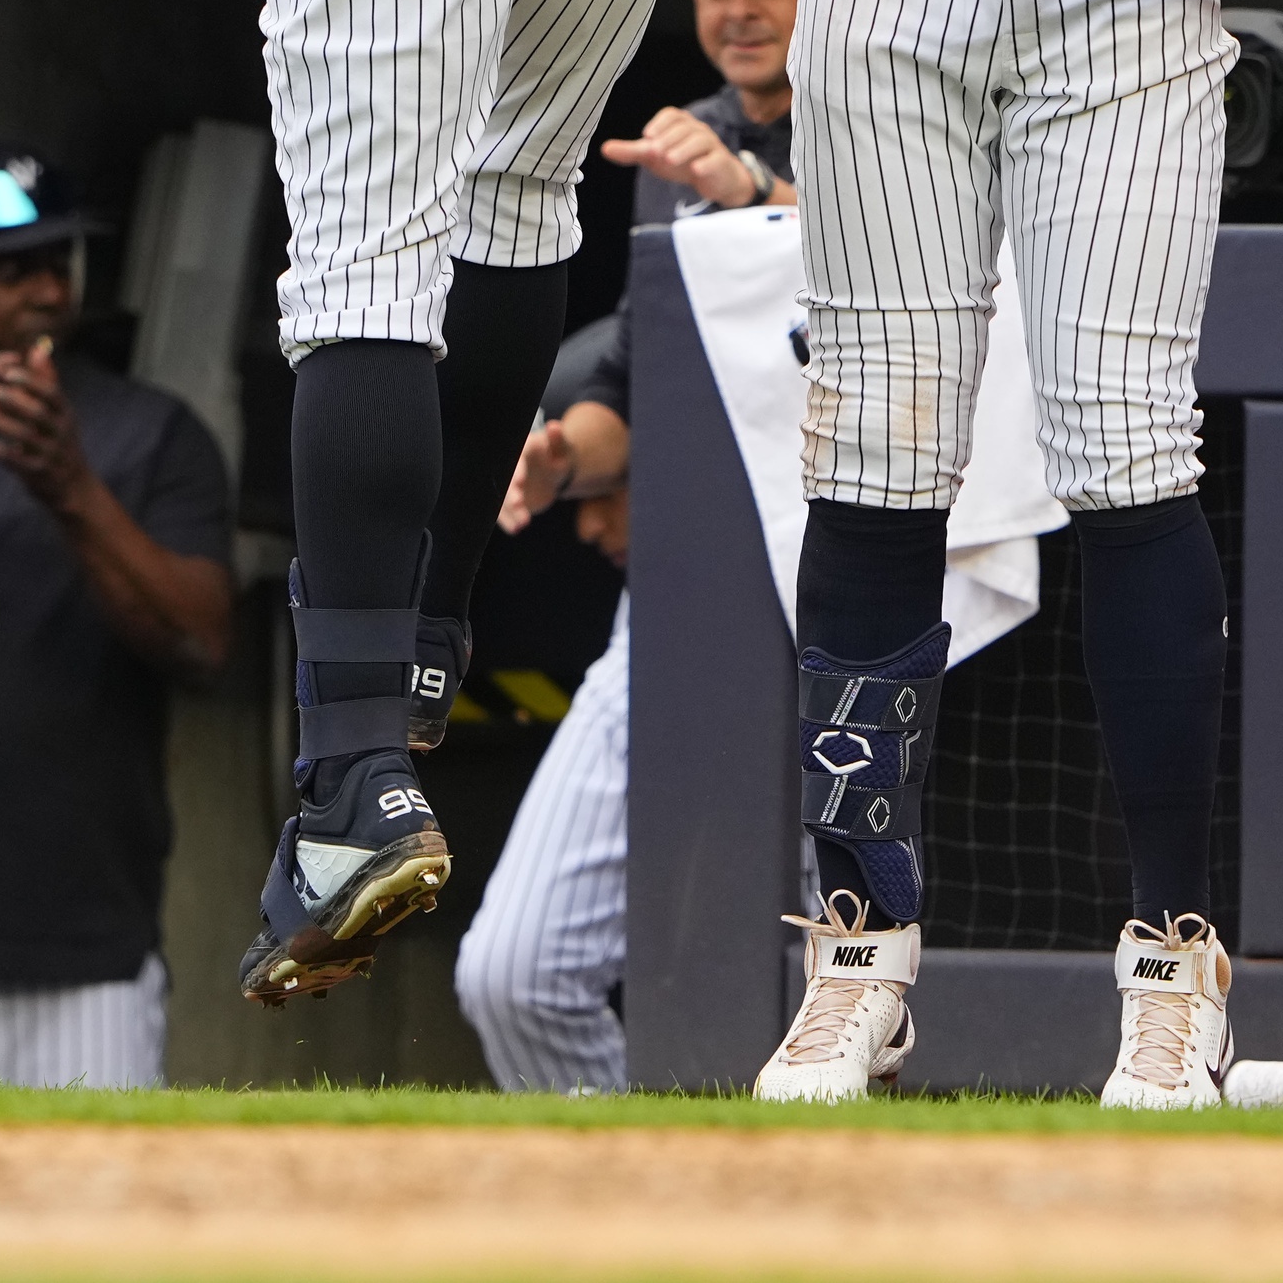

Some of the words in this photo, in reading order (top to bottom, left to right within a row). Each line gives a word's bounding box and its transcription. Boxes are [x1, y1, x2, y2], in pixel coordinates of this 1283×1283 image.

[378, 788, 434, 820] 99
[832, 946, 878, 967] NIKE
[1132, 957, 1180, 981] NIKE
